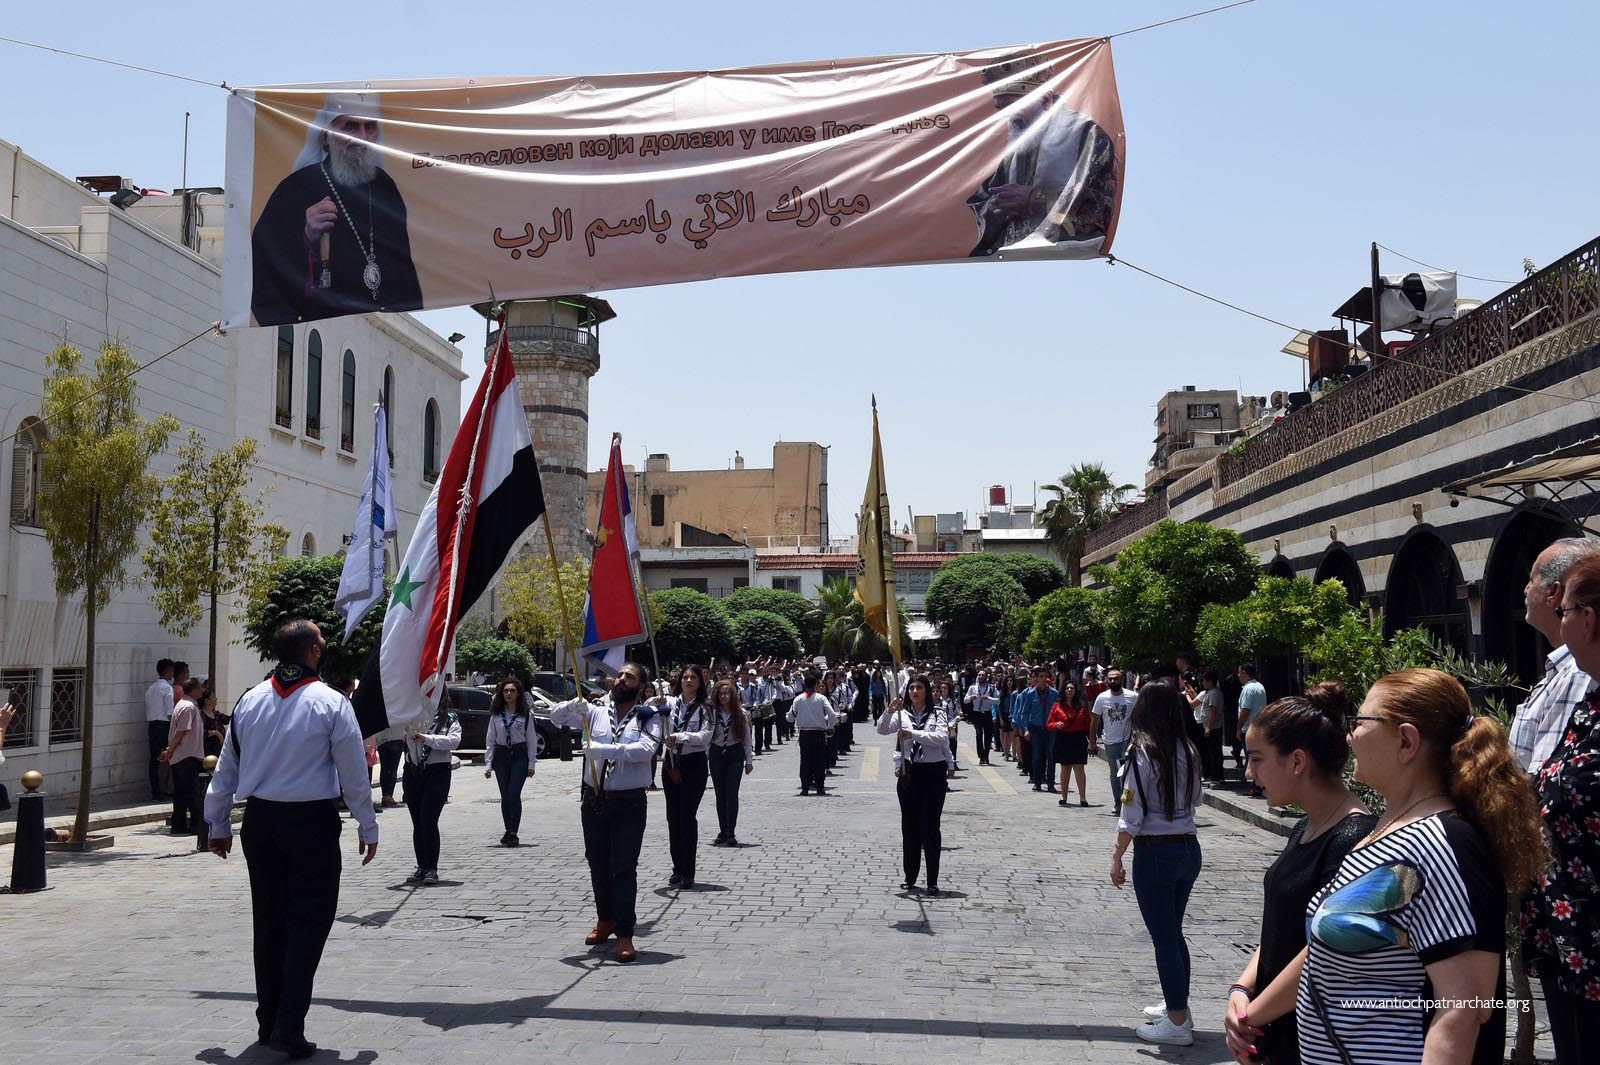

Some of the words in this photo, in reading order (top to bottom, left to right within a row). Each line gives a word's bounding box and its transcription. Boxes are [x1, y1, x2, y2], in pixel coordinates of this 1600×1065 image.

[579, 133, 634, 160] који
[640, 127, 734, 156] долази
[741, 128, 756, 149] у
[762, 126, 816, 144] име
[585, 199, 671, 257] باسم
[683, 189, 755, 249] الآتي
[766, 185, 870, 227] مبارك
[493, 207, 573, 259] الرب
